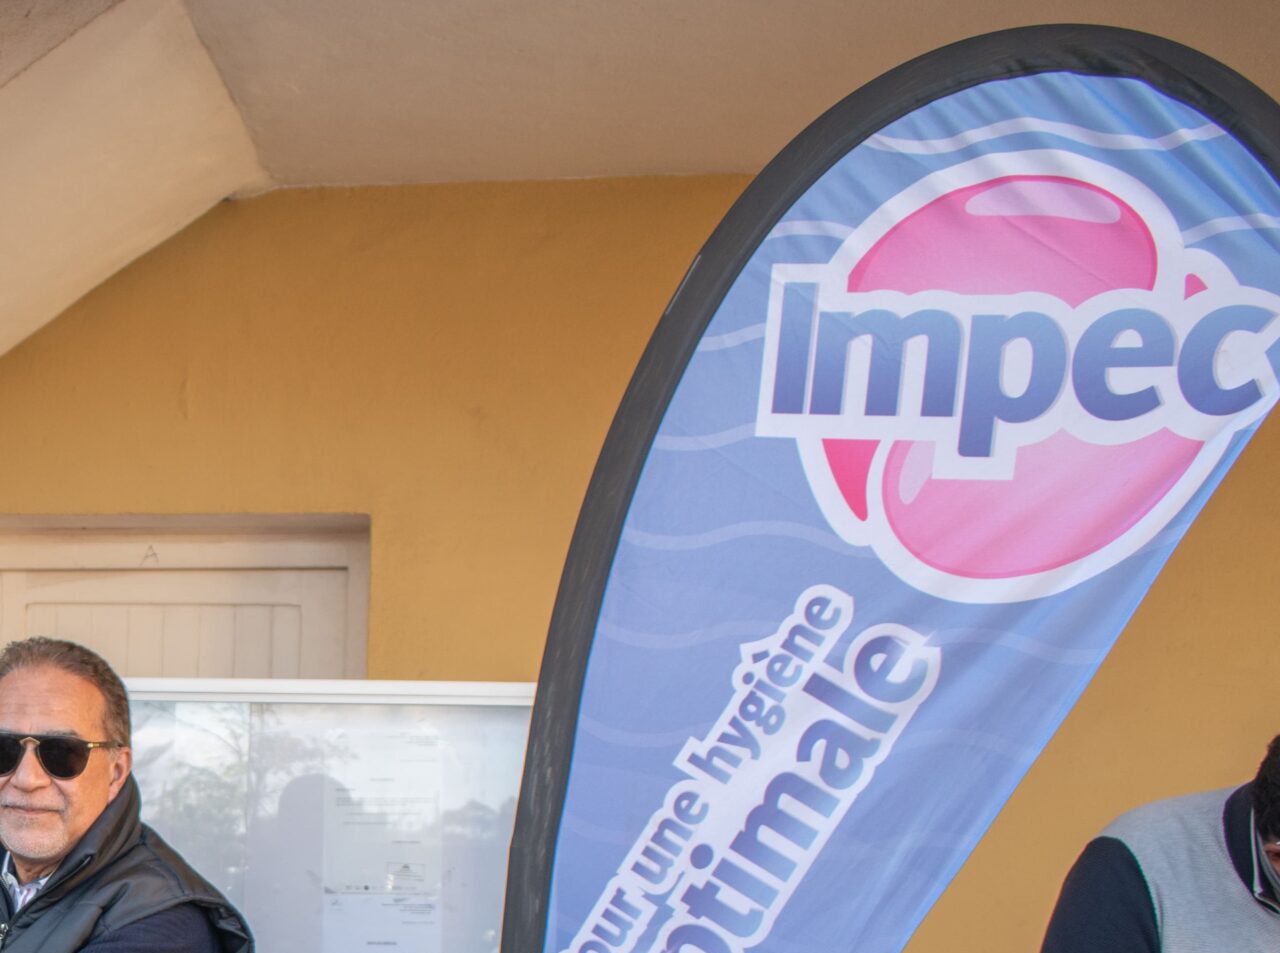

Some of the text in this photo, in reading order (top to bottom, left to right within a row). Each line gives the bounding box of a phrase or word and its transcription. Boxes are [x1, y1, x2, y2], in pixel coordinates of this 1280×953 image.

[771, 281, 1278, 457] Impec
[630, 789, 710, 886] une
[687, 595, 842, 785] hygiène
